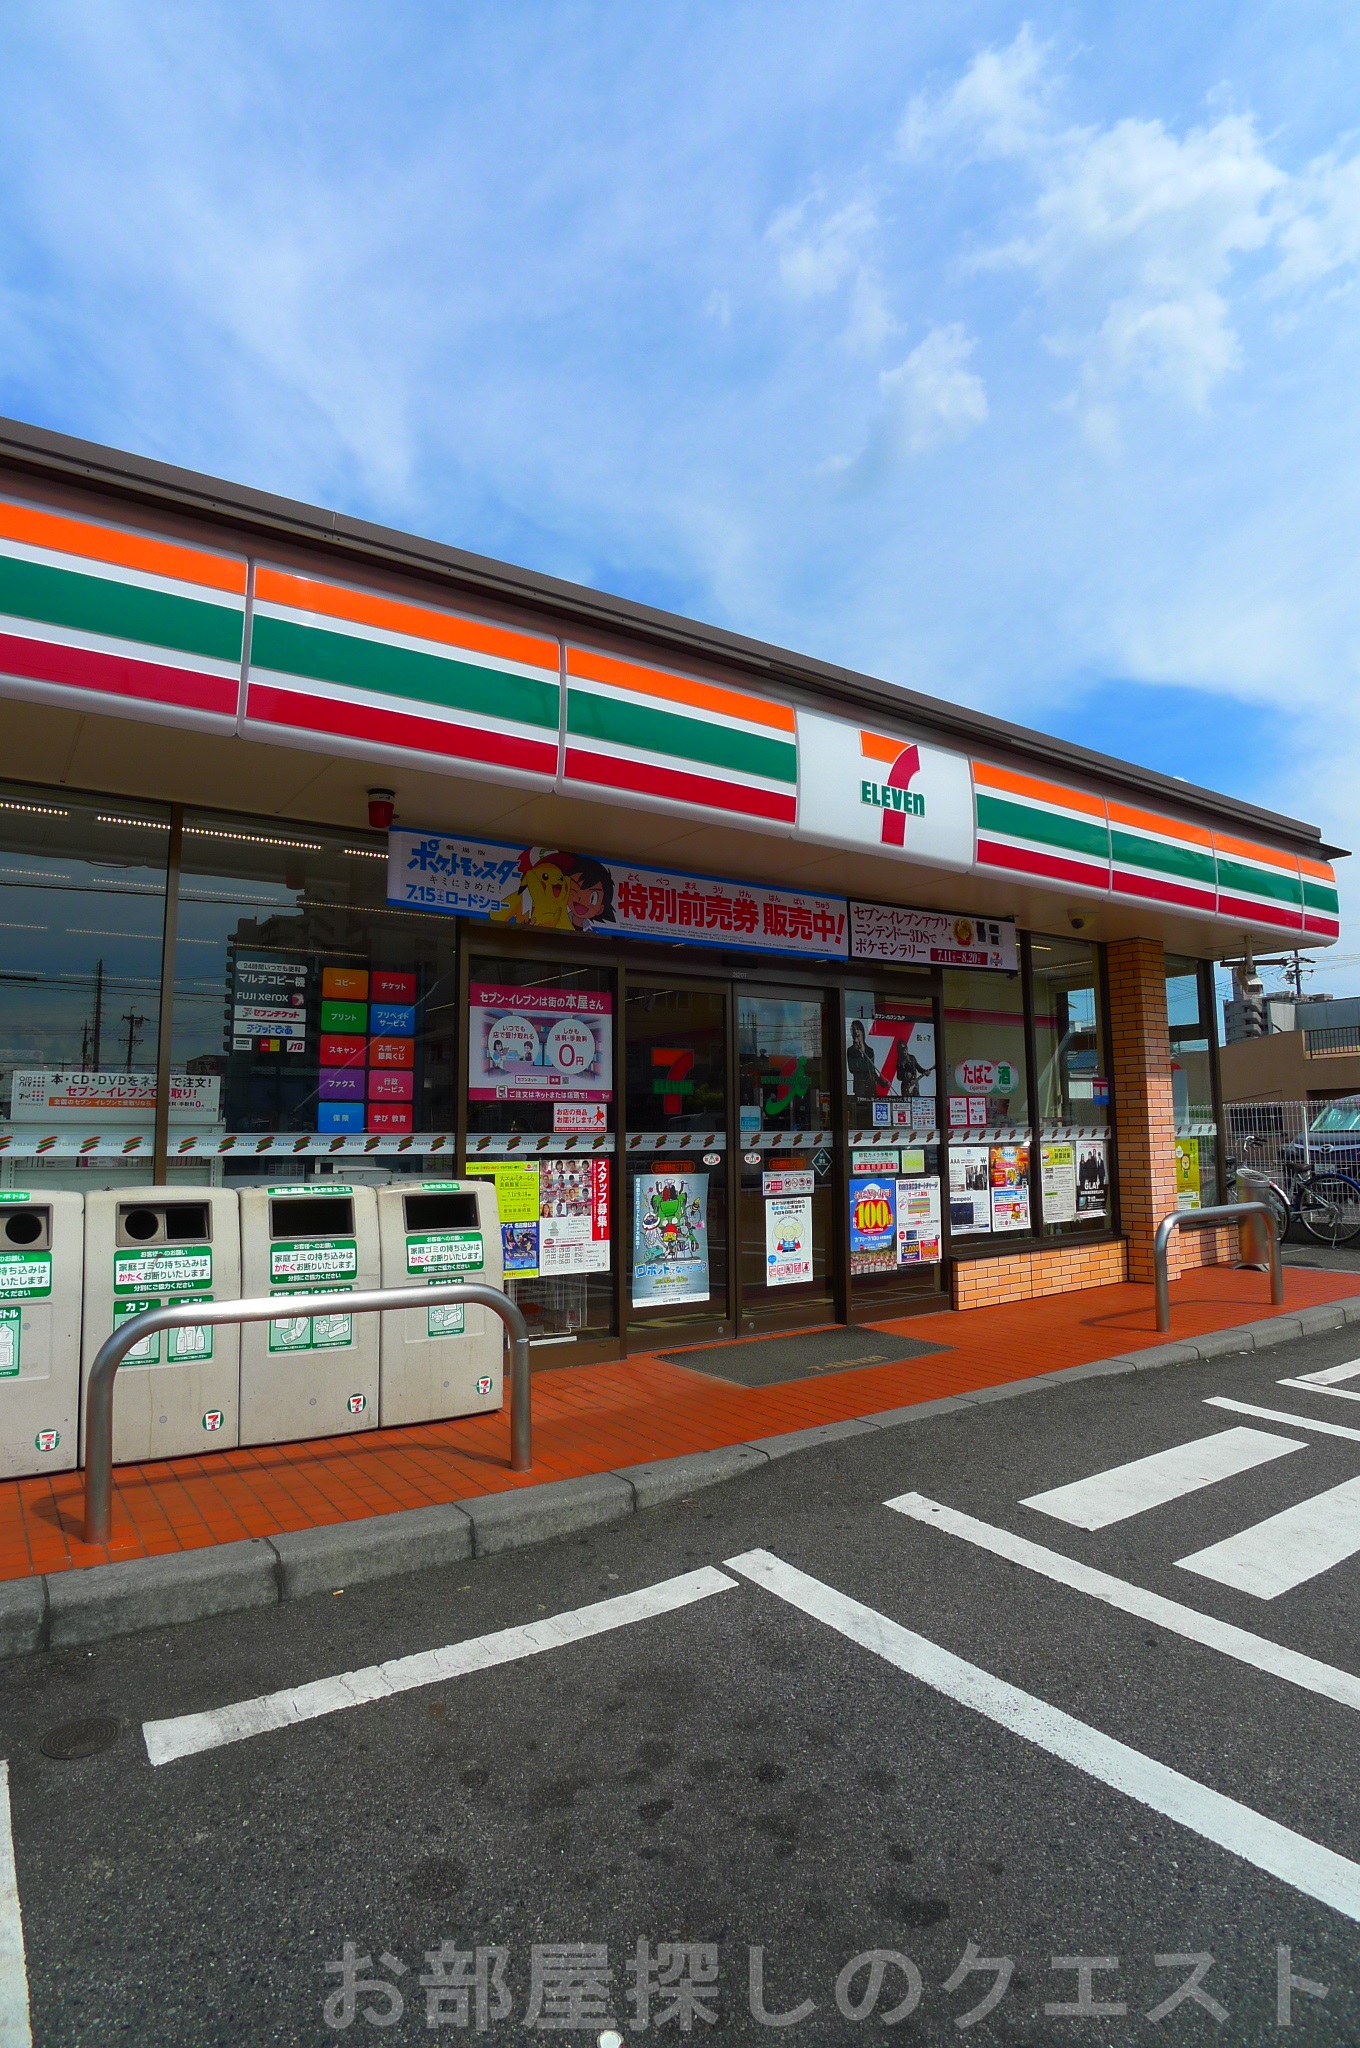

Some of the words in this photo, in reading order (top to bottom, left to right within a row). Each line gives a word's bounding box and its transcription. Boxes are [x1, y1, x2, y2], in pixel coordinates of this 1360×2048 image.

[859, 730, 920, 846] 7
[861, 779, 925, 817] ELEVEn
[407, 839, 522, 885] ポケットモンスター
[627, 873, 640, 882] とく
[656, 877, 670, 886] べつ
[685, 881, 697, 891] まえ
[713, 885, 724, 895] うり
[739, 889, 752, 899] けん
[769, 894, 781, 903] はん
[793, 897, 806, 906] ばい
[815, 901, 830, 910] ちゅう
[618, 881, 759, 934] 特別前売券
[855, 923, 937, 944] ニンテンドー3DSで
[855, 938, 926, 959] ポケモンラリー
[238, 974, 306, 988] マルチコピー機
[335, 979, 357, 987] コピー
[381, 982, 407, 990] チケット
[236, 991, 257, 1000] FUJI
[258, 992, 289, 1002] xerox
[254, 1009, 300, 1018] セブンチケット
[330, 1013, 357, 1021] プリント
[376, 1011, 410, 1019] プリペイド
[379, 1020, 407, 1028] サービス
[328, 1046, 357, 1054] スキャン
[378, 1044, 406, 1052] スポーツ
[963, 1064, 993, 1085] たばこ
[998, 1065, 1011, 1085] 酒
[328, 1080, 356, 1088] ファクス
[383, 1078, 399, 1086] 行政
[410, 1243, 481, 1255] 家庭ゴミの持ち込みは
[274, 1251, 354, 1263] 家庭ゴミの持ち込みは
[118, 1258, 208, 1273] 家庭ゴミの持ち込みは
[133, 1281, 195, 1291] 分別にご協力ください
[126, 1301, 149, 1312] カン
